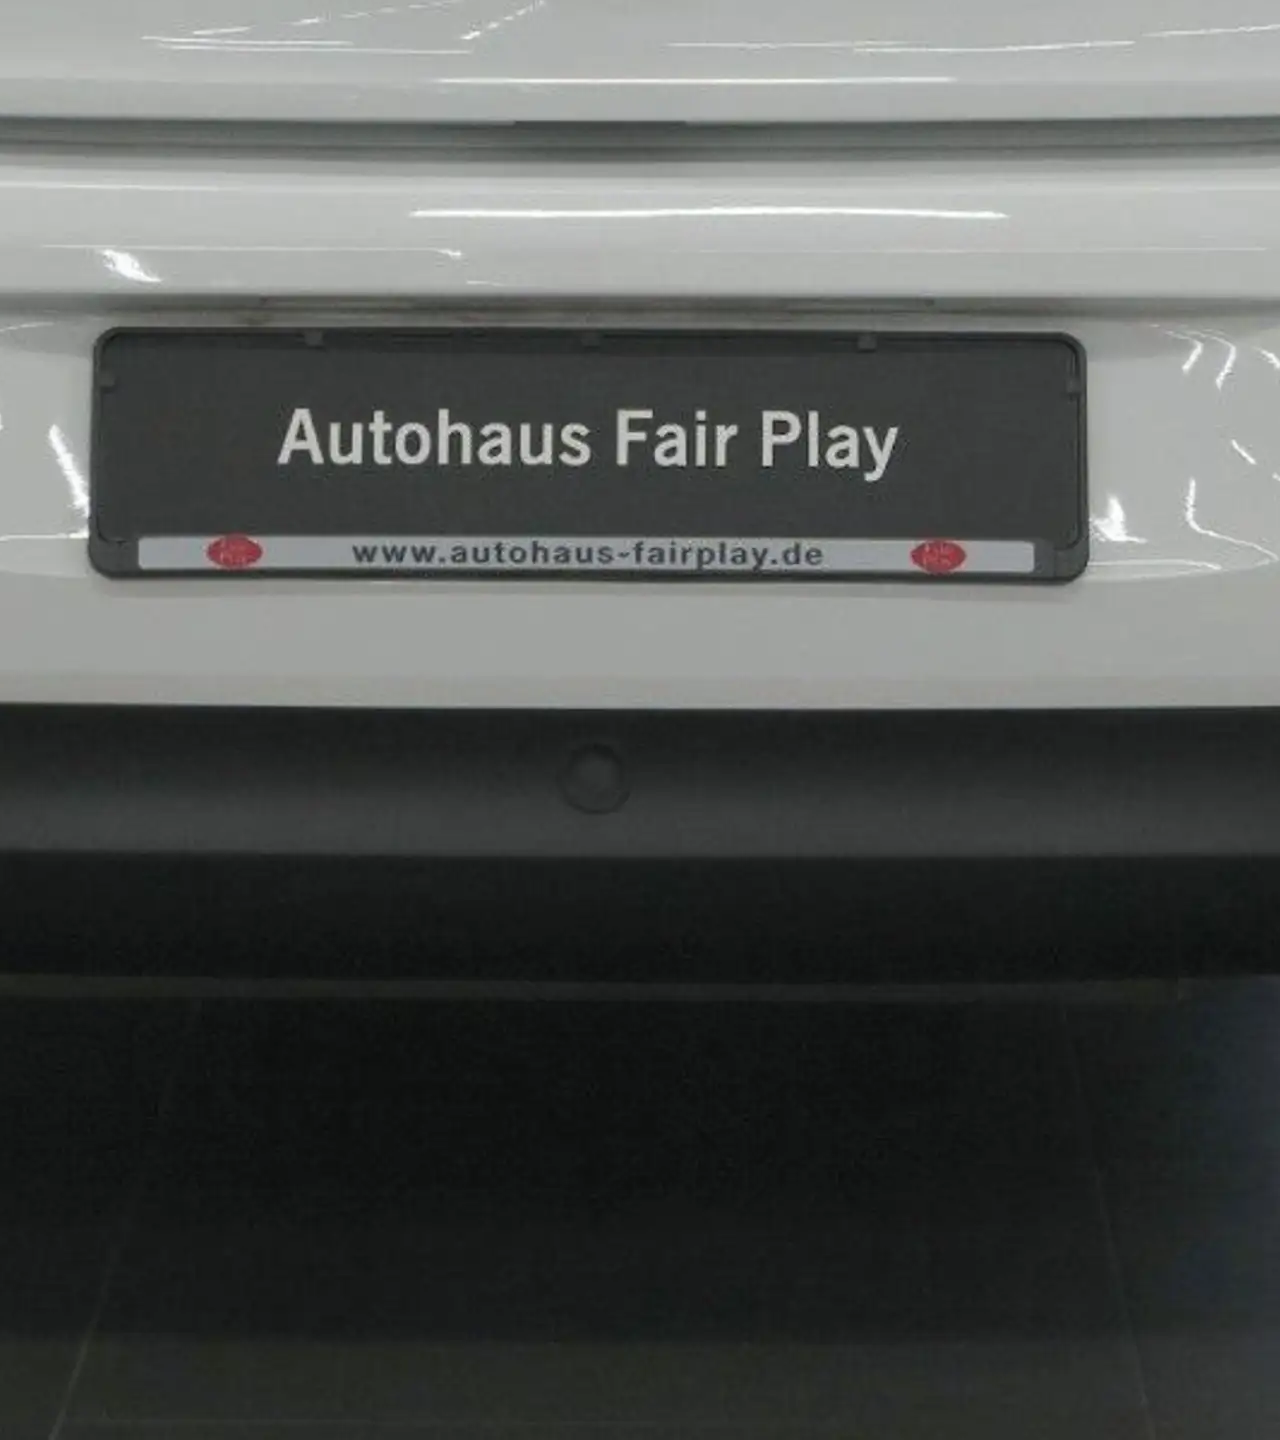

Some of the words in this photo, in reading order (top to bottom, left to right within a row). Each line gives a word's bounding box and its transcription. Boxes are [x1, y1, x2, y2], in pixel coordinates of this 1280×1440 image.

[277, 407, 591, 467] Autohaus
[616, 408, 739, 467] Fair
[761, 410, 899, 483] Play
[352, 540, 823, 572] www.autohaus-fairplay.de
